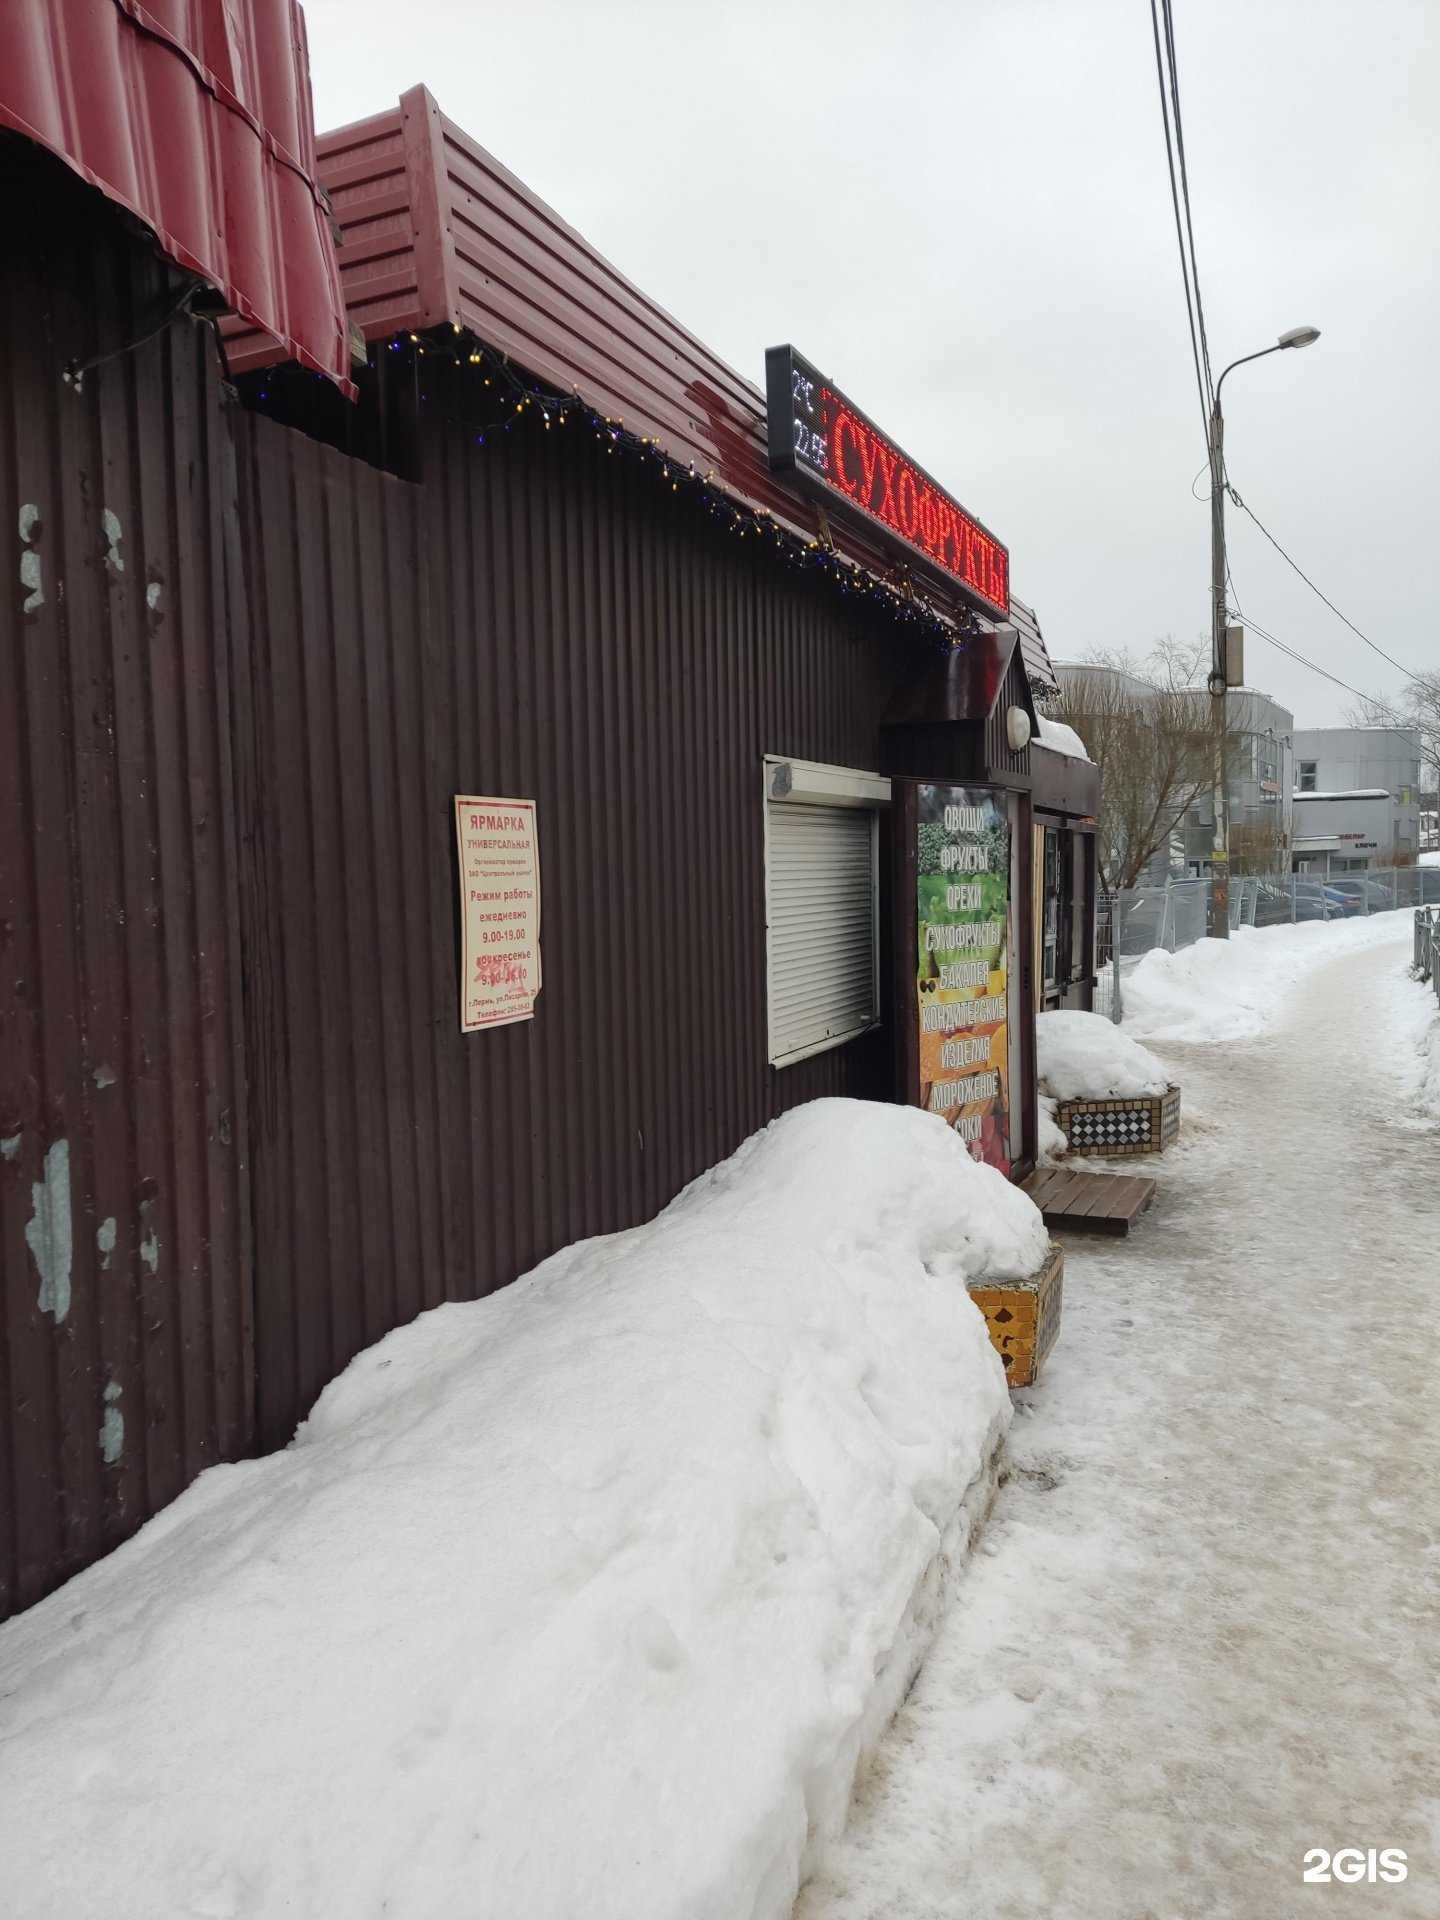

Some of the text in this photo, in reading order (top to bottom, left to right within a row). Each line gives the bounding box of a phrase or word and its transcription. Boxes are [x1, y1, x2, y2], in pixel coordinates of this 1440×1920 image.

[834, 412, 1008, 612] СУХОФРУКТЫ
[470, 814, 525, 831] ЯРМАРКА
[944, 806, 985, 833] ОВОЩИ
[467, 839, 530, 849] УНИВЕРСАЛЬНАЯ
[941, 846, 989, 872] ФРУКТЫ
[470, 888, 533, 902] Режим работы
[947, 885, 982, 910] ОРЕХИ
[480, 910, 527, 922] ежедневно
[482, 928, 526, 944] 9.00-19.00
[926, 922, 1000, 951] СУХОФРУКТЫ
[940, 961, 989, 989] БАКАЛЕЯ
[922, 996, 1006, 1033] КОНДИТЕРСКИЕ
[941, 1035, 992, 1069] ИЗДЕЛИЯ
[932, 1072, 999, 1111] МОРОЖЕНОЕ
